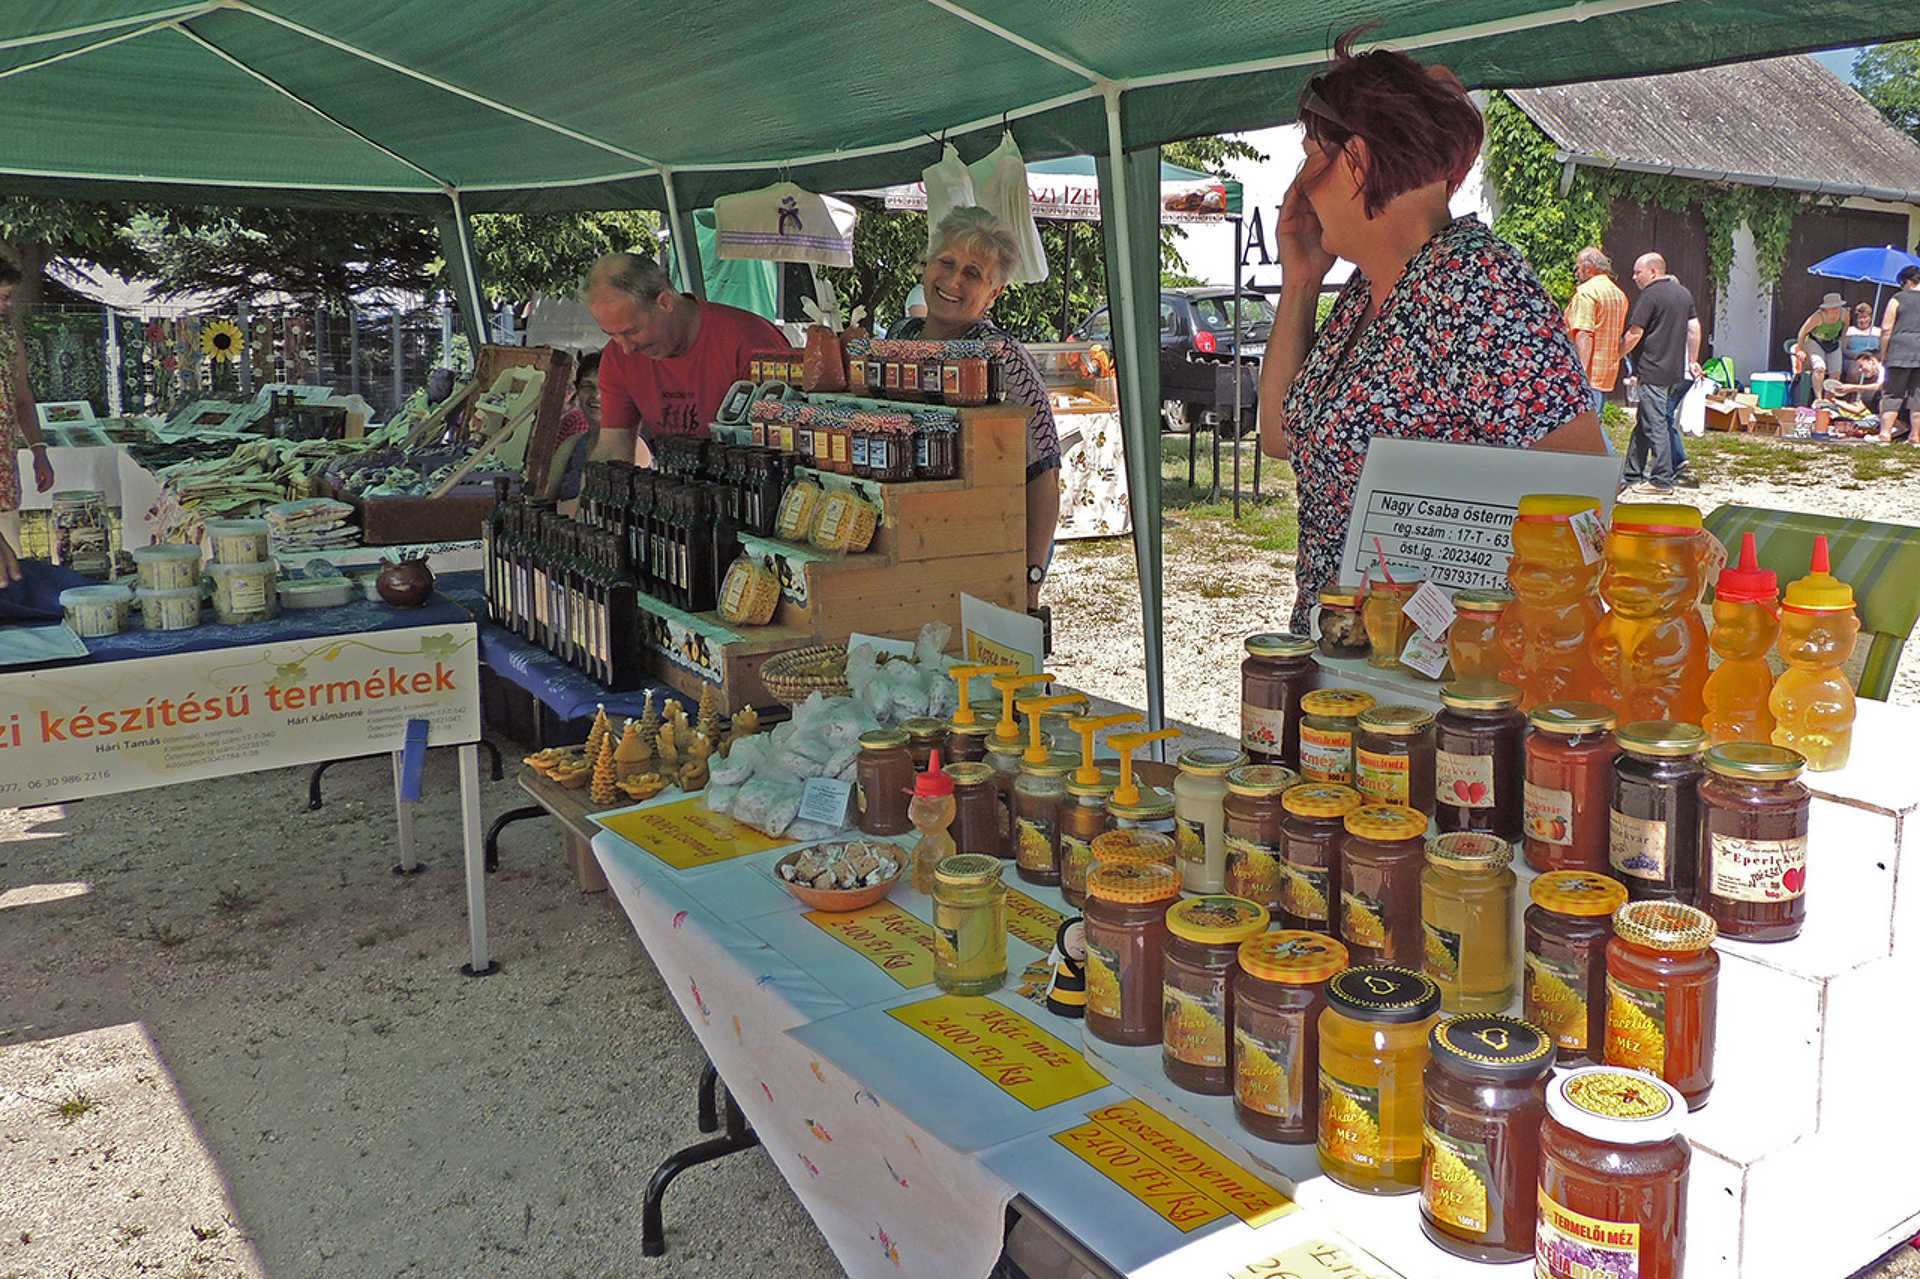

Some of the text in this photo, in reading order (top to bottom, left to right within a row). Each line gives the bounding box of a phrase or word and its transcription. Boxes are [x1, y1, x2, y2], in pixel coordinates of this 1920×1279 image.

[1381, 496, 1414, 516] Nagy
[1418, 500, 1460, 519] Csaba
[1393, 521, 1445, 539] reg.szám
[1457, 528, 1483, 543] 17-T
[40, 688, 250, 743] készítésű
[264, 662, 456, 712] termékek
[124, 736, 161, 750] Tamás
[28, 780, 41, 790] 06
[46, 777, 58, 787] 30
[965, 1009, 1072, 1068] Akác méz
[1617, 1036, 1641, 1053] MÉZ
[921, 1016, 1034, 1087] 2400 Ft/kg
[1336, 1127, 1358, 1143] MÉZ
[1093, 1106, 1273, 1212] Gesztenyeméz
[1069, 1128, 1211, 1222] 2400 Ft/kg
[1440, 1187, 1465, 1206] MÉZ
[1553, 1211, 1634, 1246] TERMELŐI MÉZ
